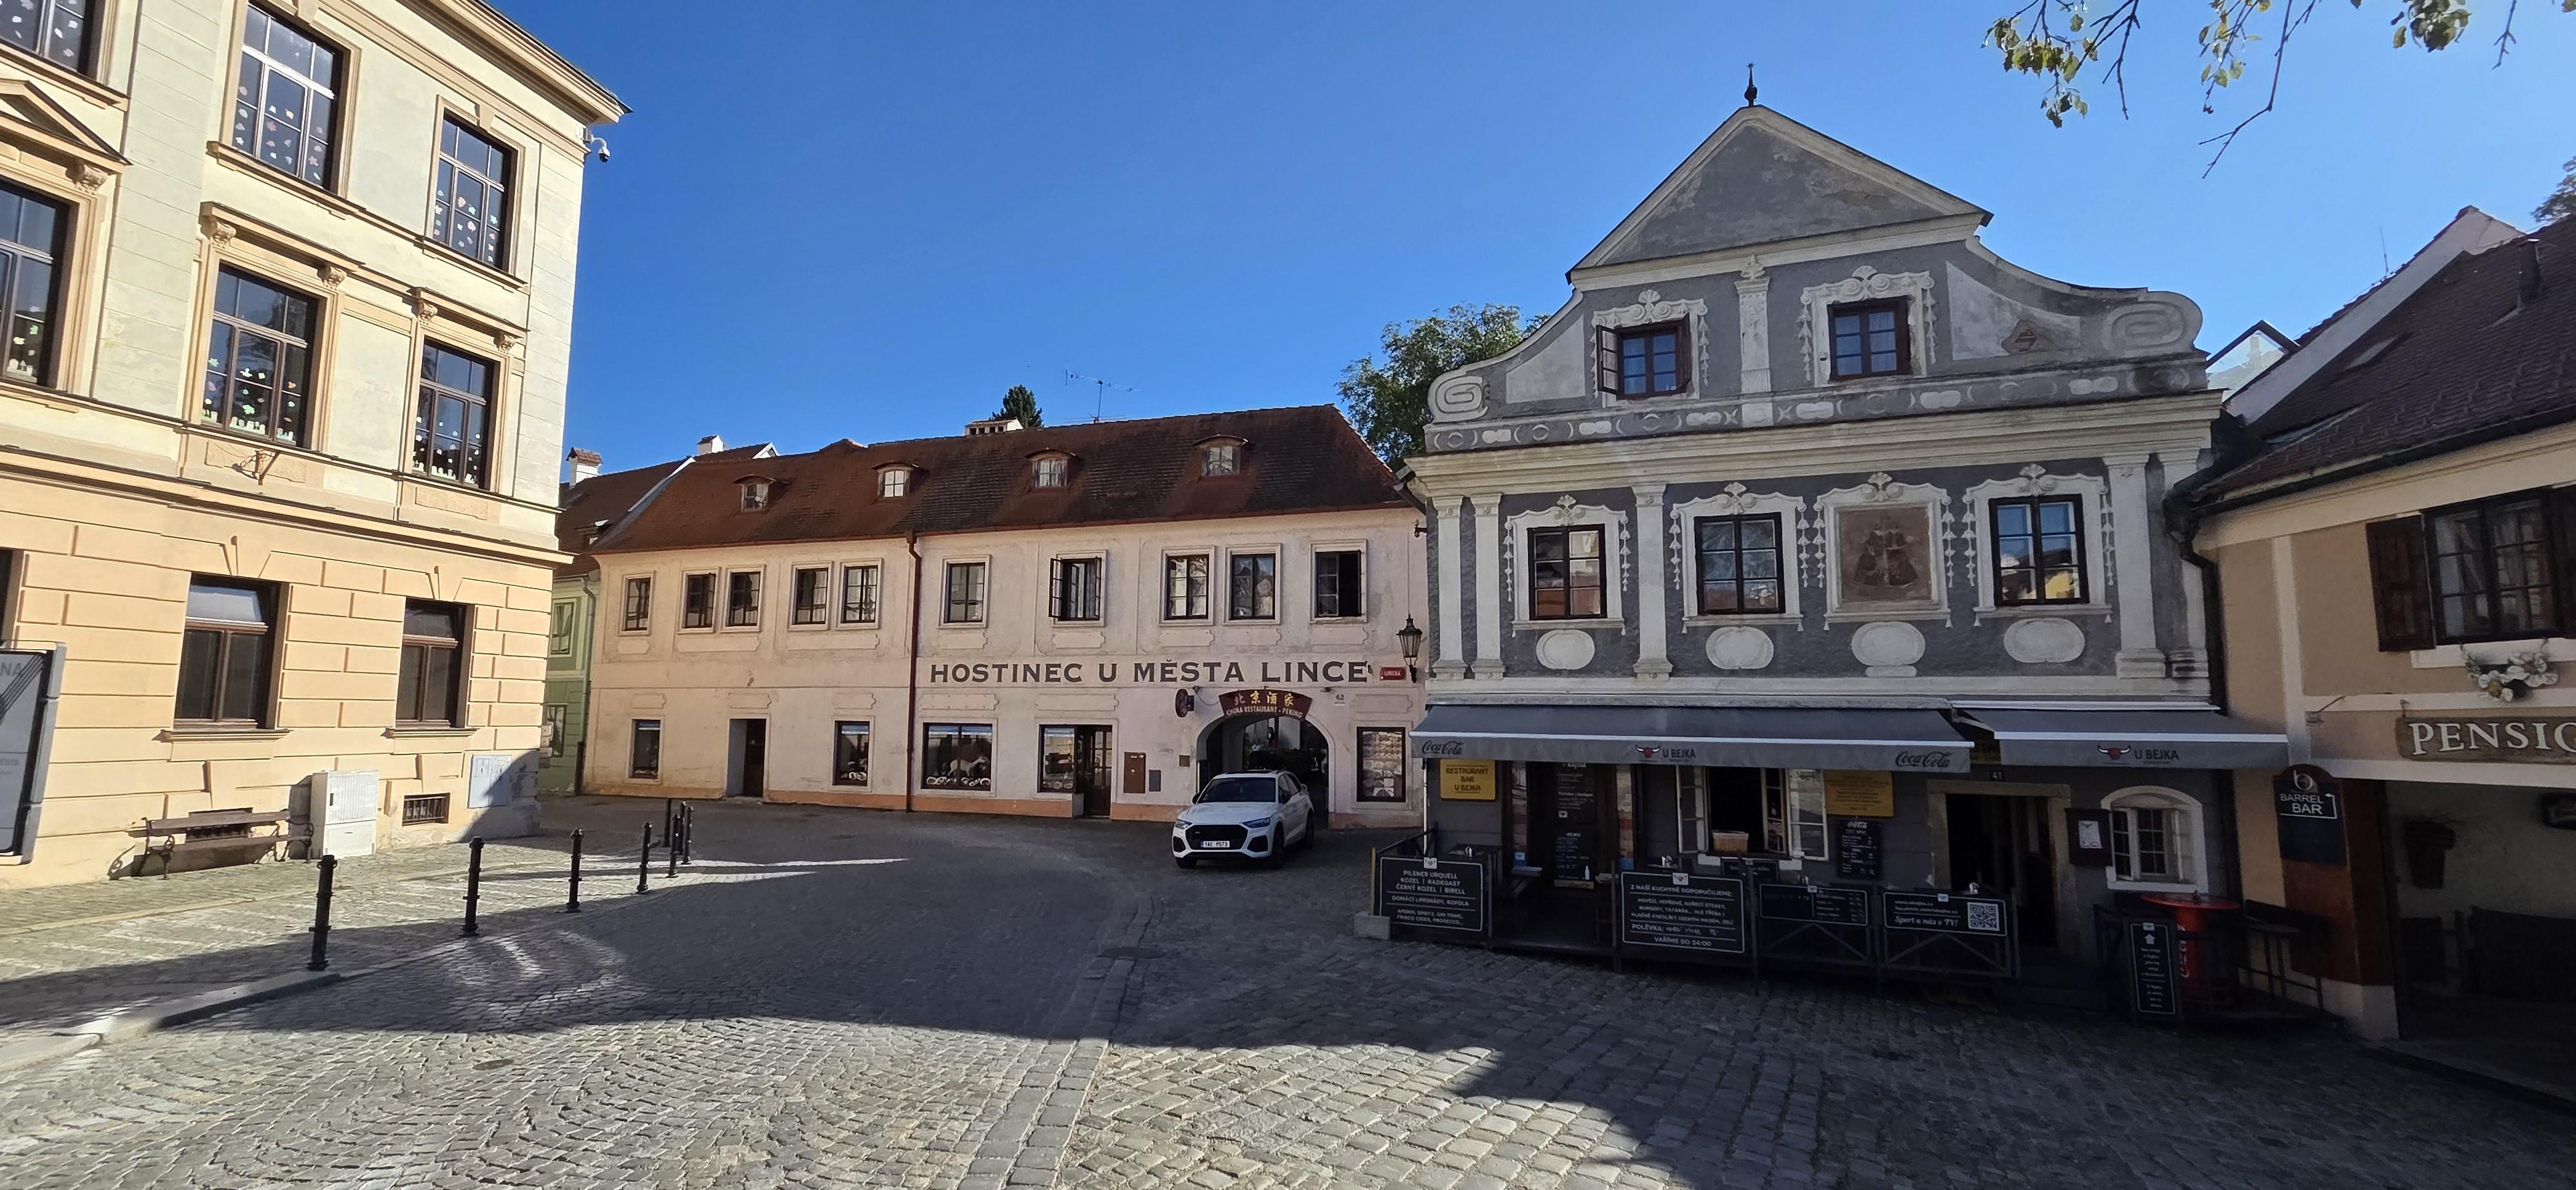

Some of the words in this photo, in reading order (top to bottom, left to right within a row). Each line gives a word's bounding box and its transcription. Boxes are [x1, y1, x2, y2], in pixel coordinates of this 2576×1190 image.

[930, 663, 1083, 683] HOSTINEC
[1099, 663, 1117, 683] U
[1133, 659, 1245, 683] MĚSTA
[1261, 661, 1368, 683] LINCE
[1233, 690, 1294, 707] 北京酒家
[1226, 707, 1244, 717] CHINA
[1282, 708, 1303, 719] PEKING
[1663, 749, 1669, 758] U
[2134, 750, 2142, 759] U
[2146, 750, 2179, 760] BEJKA
[1445, 767, 1489, 775] RESTAURANT
[2280, 793, 2324, 804] BARREL
[2292, 803, 2323, 815] BAR
[1430, 871, 1458, 880] URQUELL
[1895, 916, 1915, 925] Sport
[1922, 918, 1937, 926] nás
[1944, 919, 1958, 927] TV!
[1653, 936, 1679, 944] VAŘÍME
